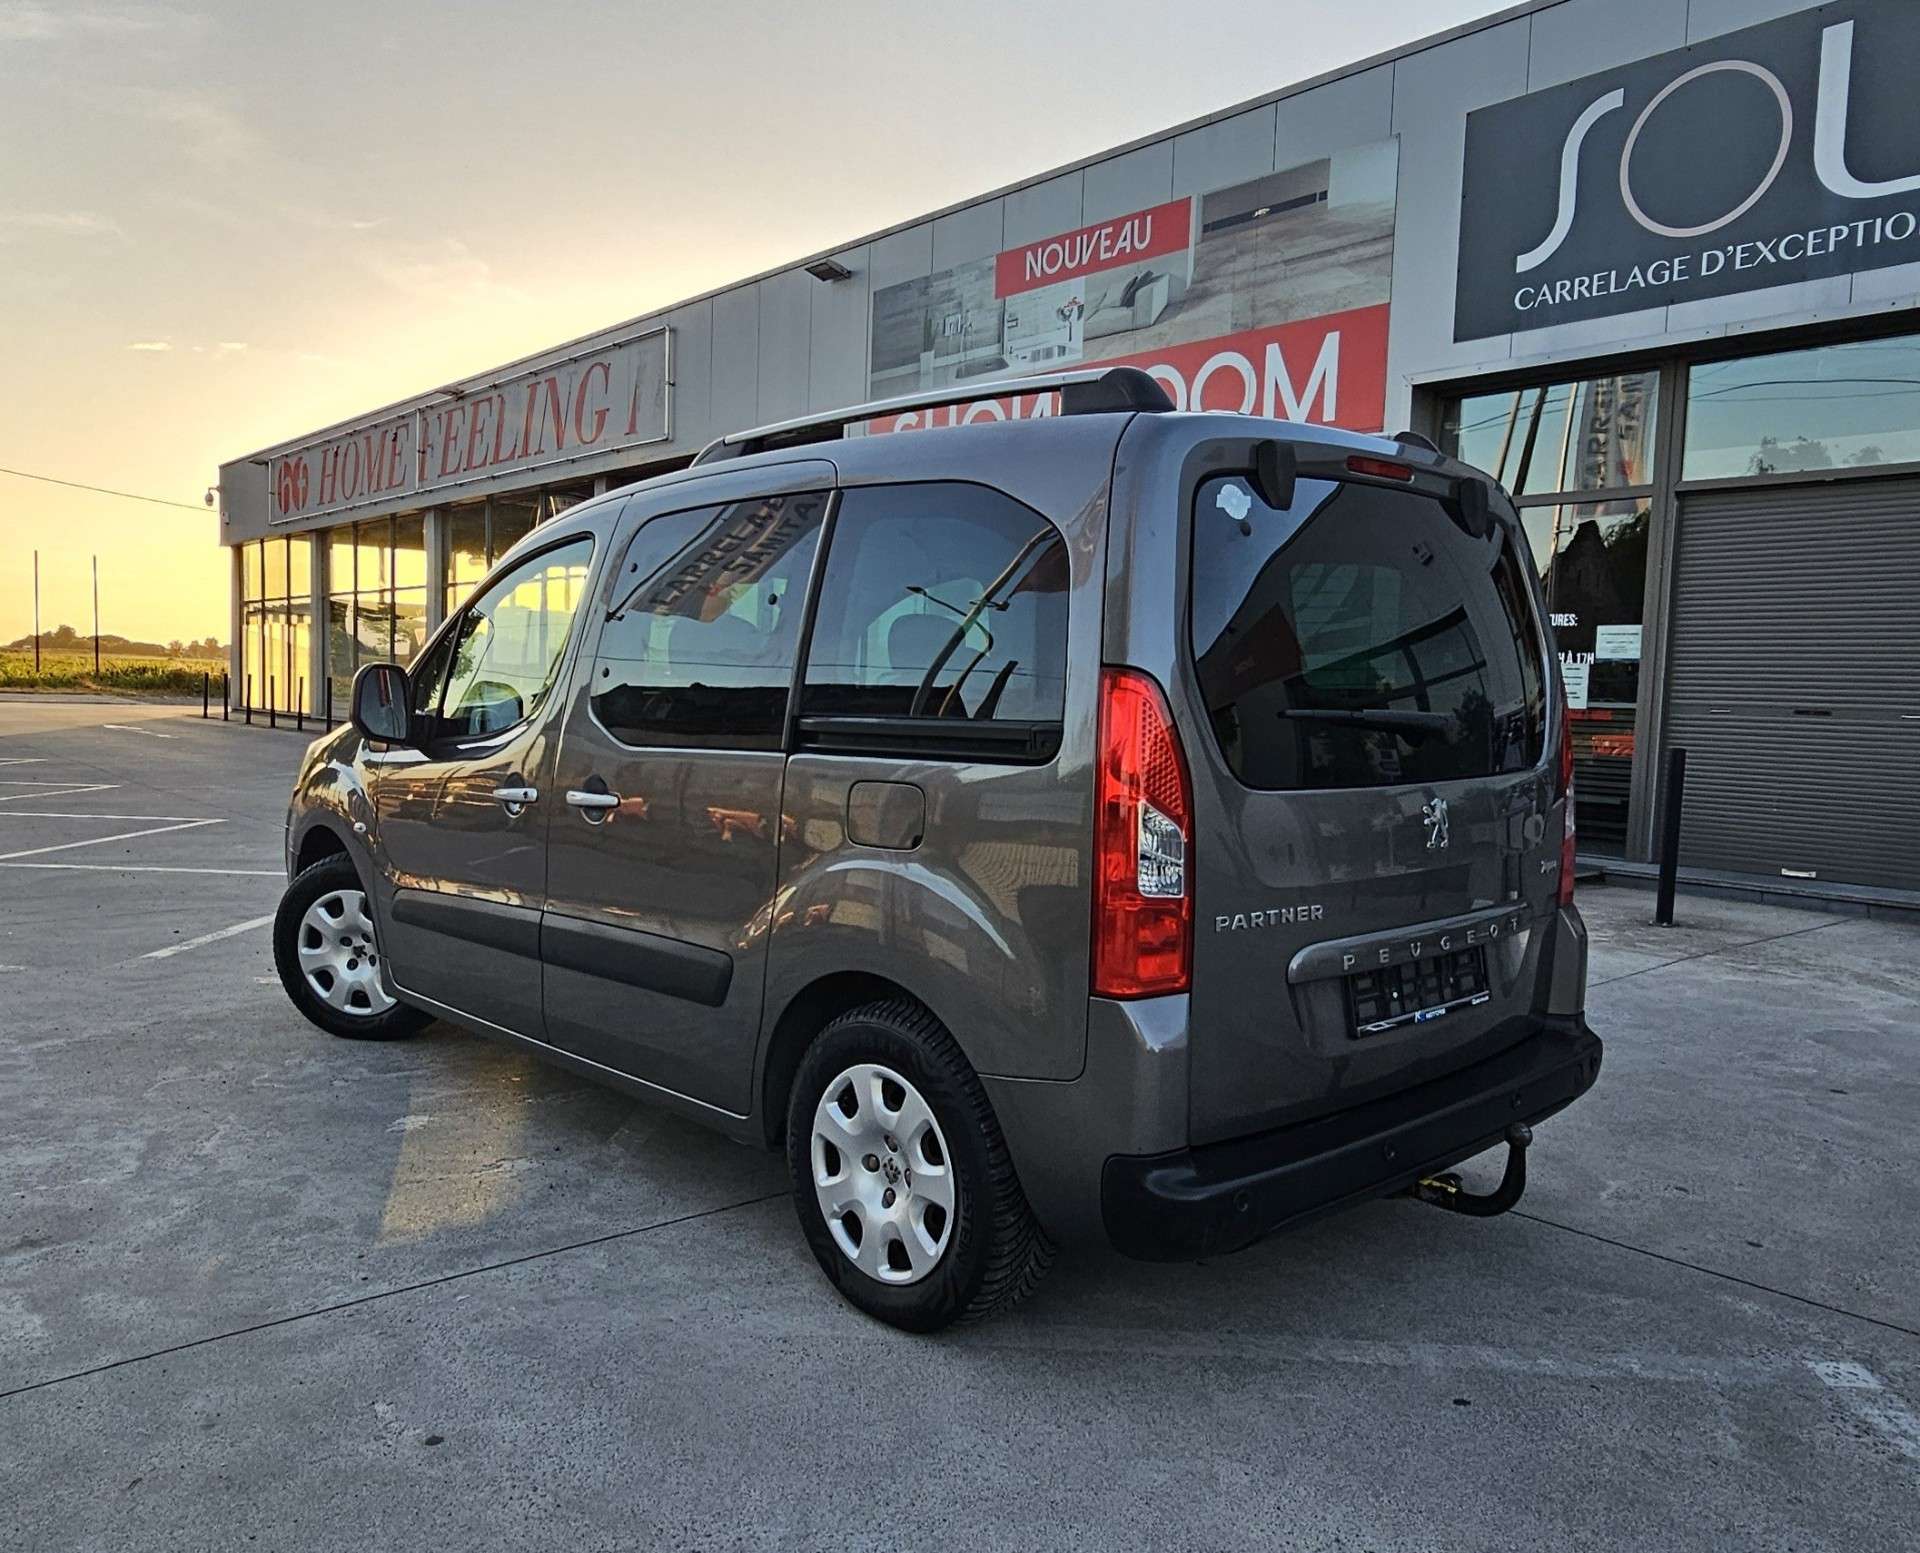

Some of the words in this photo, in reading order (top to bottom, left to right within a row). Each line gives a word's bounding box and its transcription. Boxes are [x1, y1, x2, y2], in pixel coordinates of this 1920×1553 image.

[1025, 214, 1152, 281] NOUVEAU
[1515, 256, 1690, 311] CARRELAGE
[1701, 212, 1920, 277] D'EXCEPTIO
[317, 421, 410, 506] HOME
[418, 361, 611, 481] FEELING
[1215, 903, 1324, 933] PARTNER
[1343, 918, 1520, 971] PEUGEOT
